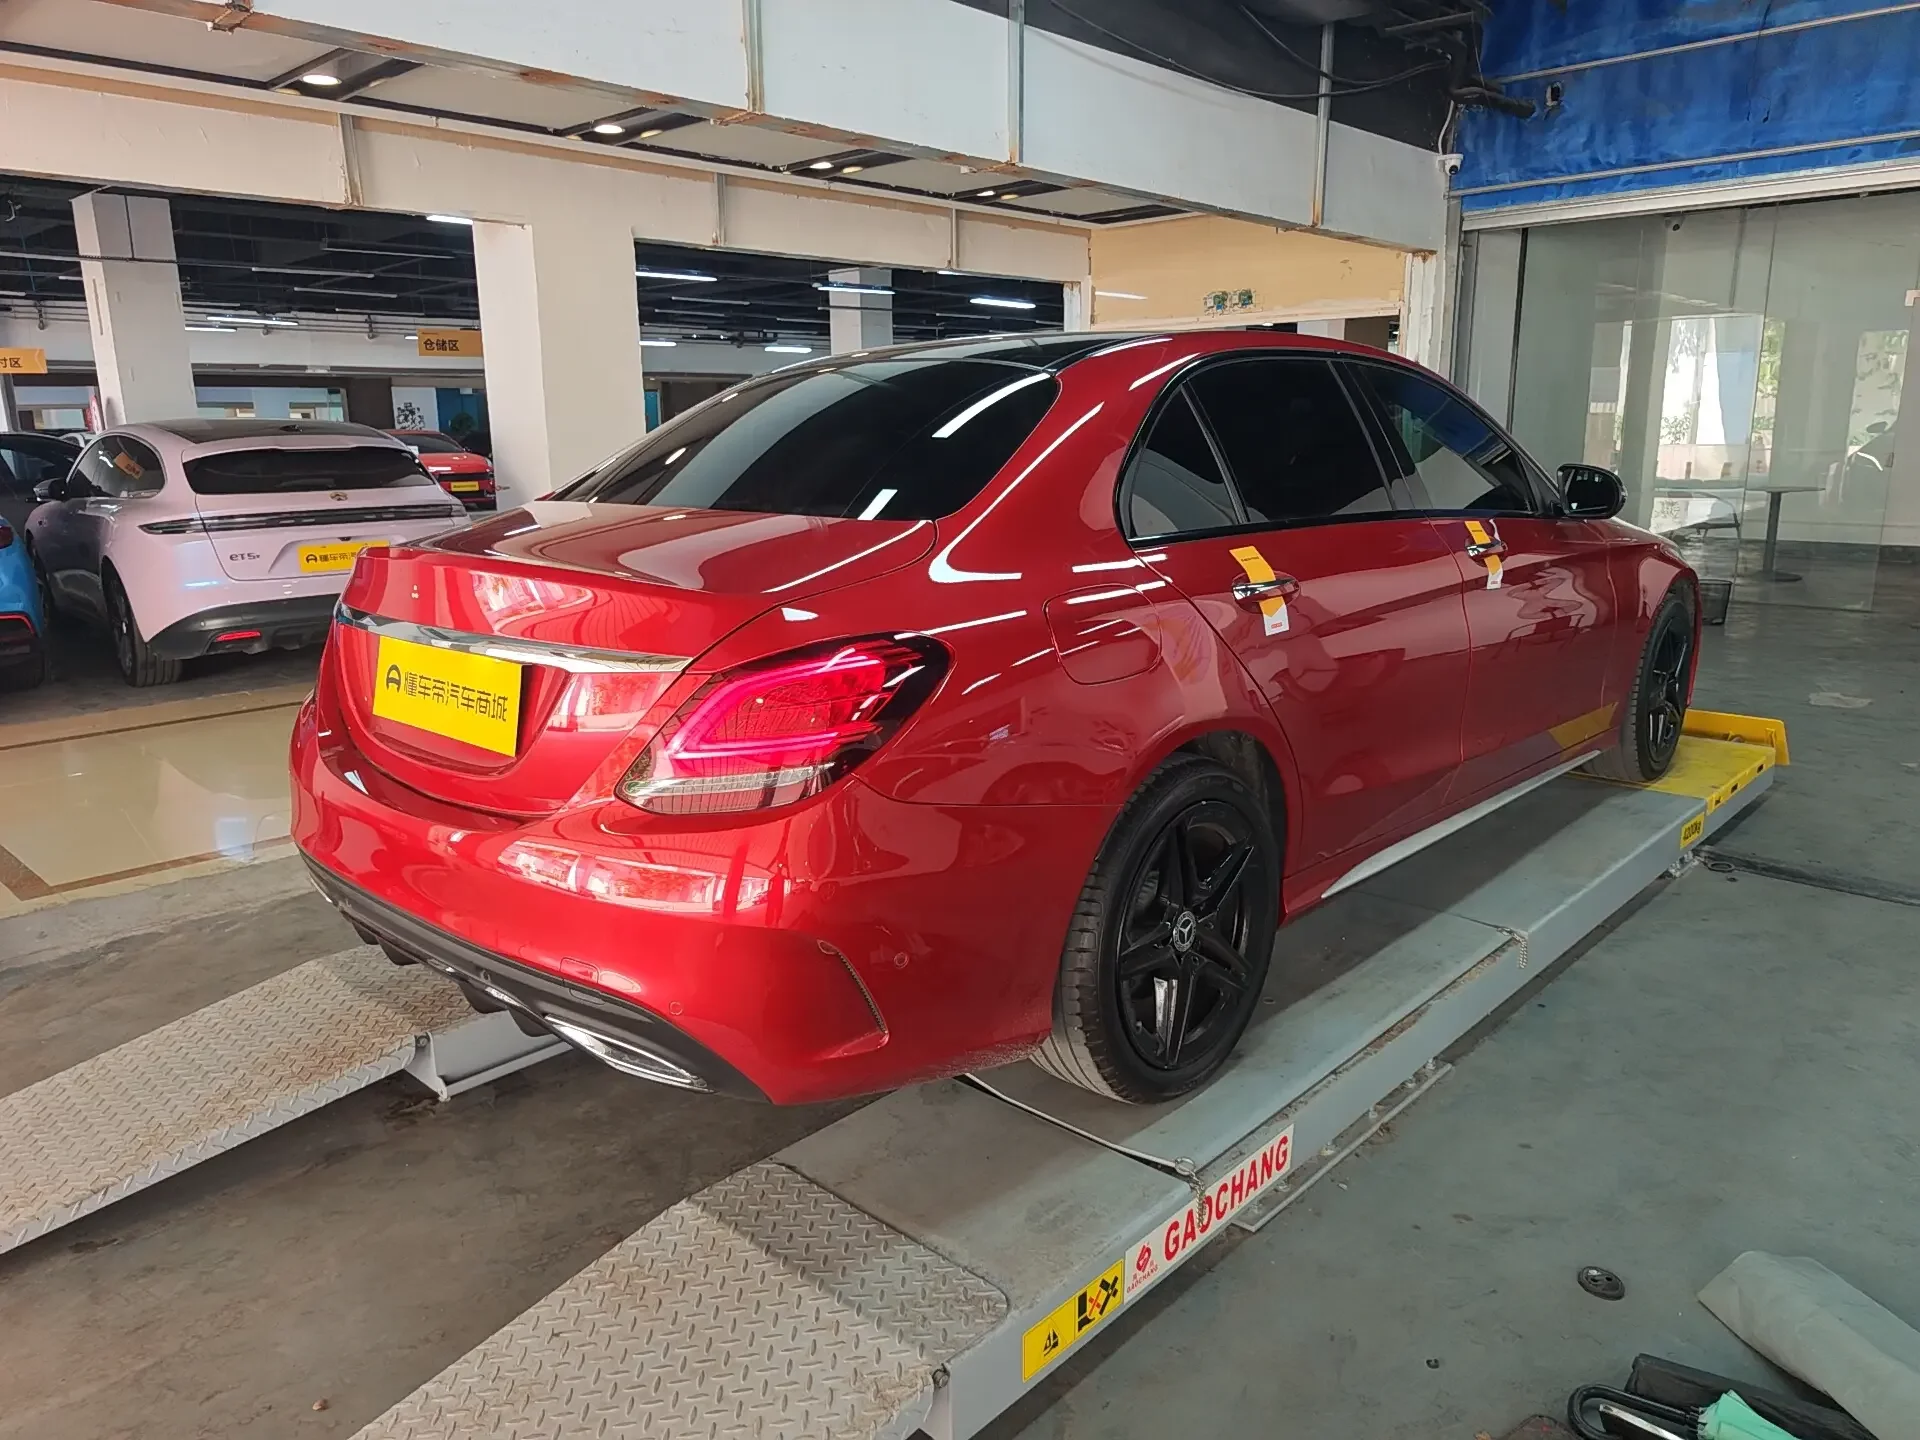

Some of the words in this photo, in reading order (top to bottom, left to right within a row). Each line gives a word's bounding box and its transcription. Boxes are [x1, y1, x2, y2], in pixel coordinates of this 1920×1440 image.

[423, 338, 460, 352] 仓储区
[404, 670, 509, 722] 懂车帝汽车商城
[1163, 1135, 1289, 1262] GAOCHANG
